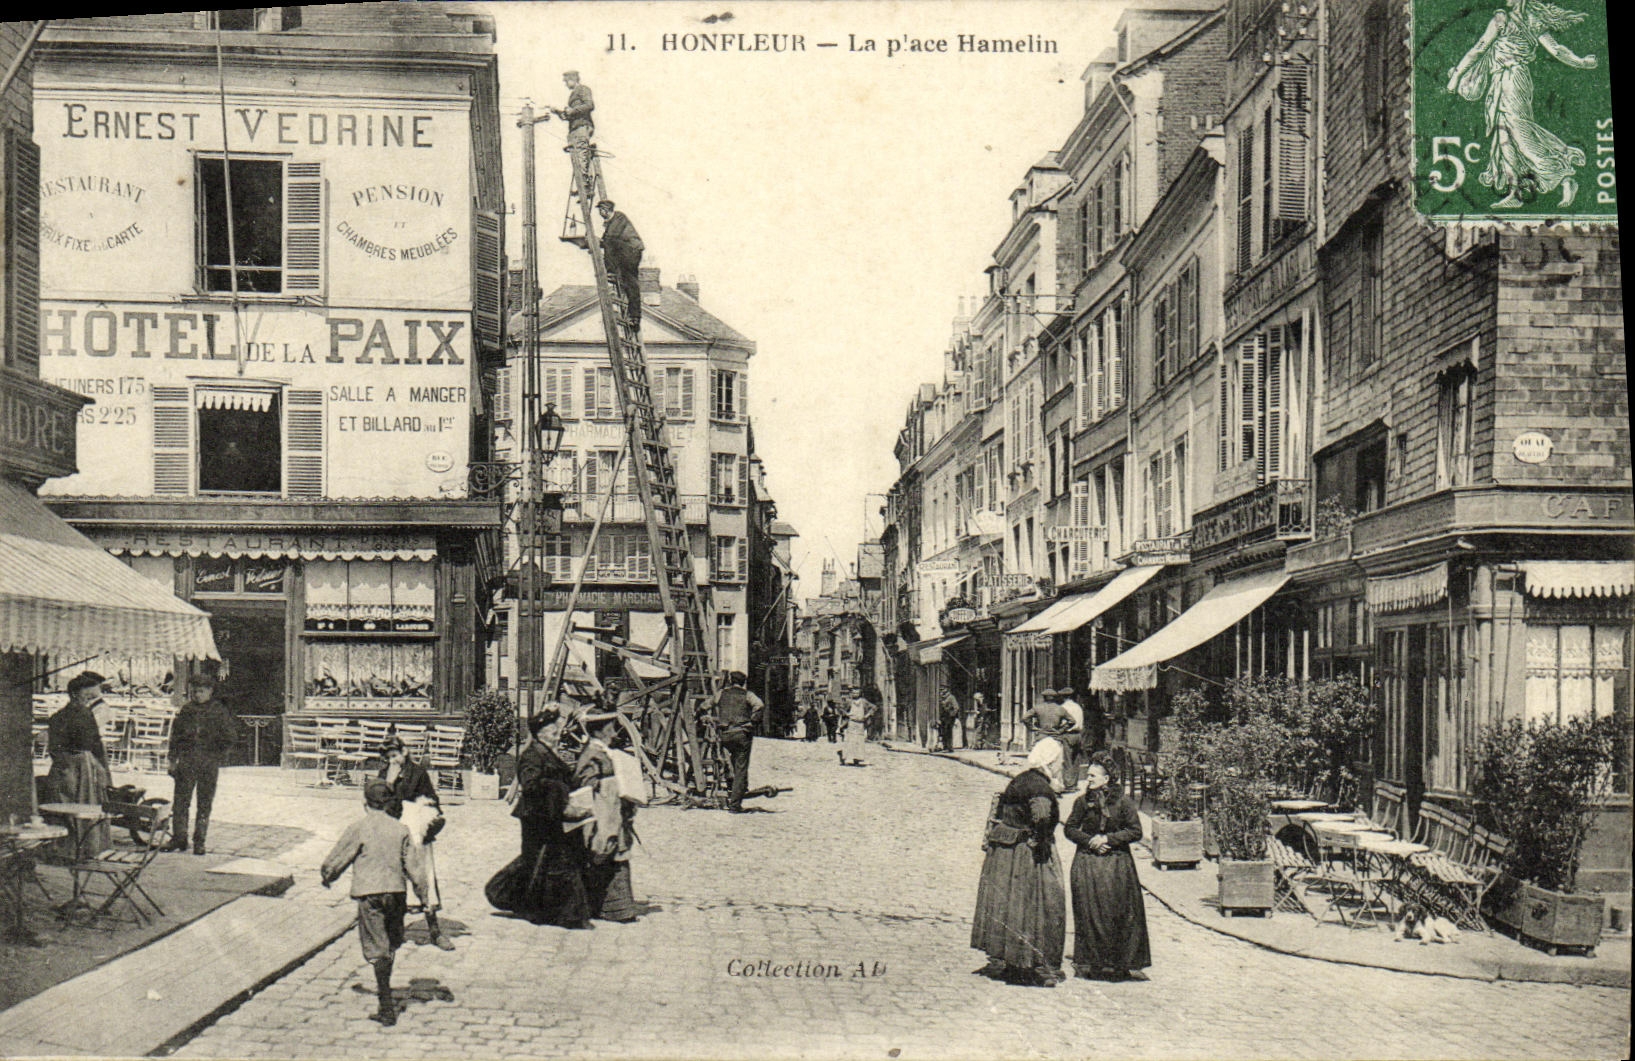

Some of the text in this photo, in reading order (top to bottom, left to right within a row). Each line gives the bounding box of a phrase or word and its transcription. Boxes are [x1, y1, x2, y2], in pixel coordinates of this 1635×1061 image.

[63, 103, 433, 148] ERNEST VEDRINE
[1596, 117, 1616, 204] POSTES
[352, 184, 444, 207] PENSION
[106, 222, 143, 249] CARTE
[336, 220, 396, 261] CHAMBRES
[246, 342, 275, 362] DE
[283, 343, 316, 363] LA
[325, 317, 464, 365] PAIX
[329, 385, 467, 403] SALLE A MANGER
[0, 391, 66, 455] IDRE
[340, 416, 357, 432] ET
[363, 416, 421, 432] BILLARD
[562, 424, 626, 441] PHARMACI
[1541, 494, 1624, 518] CAF
